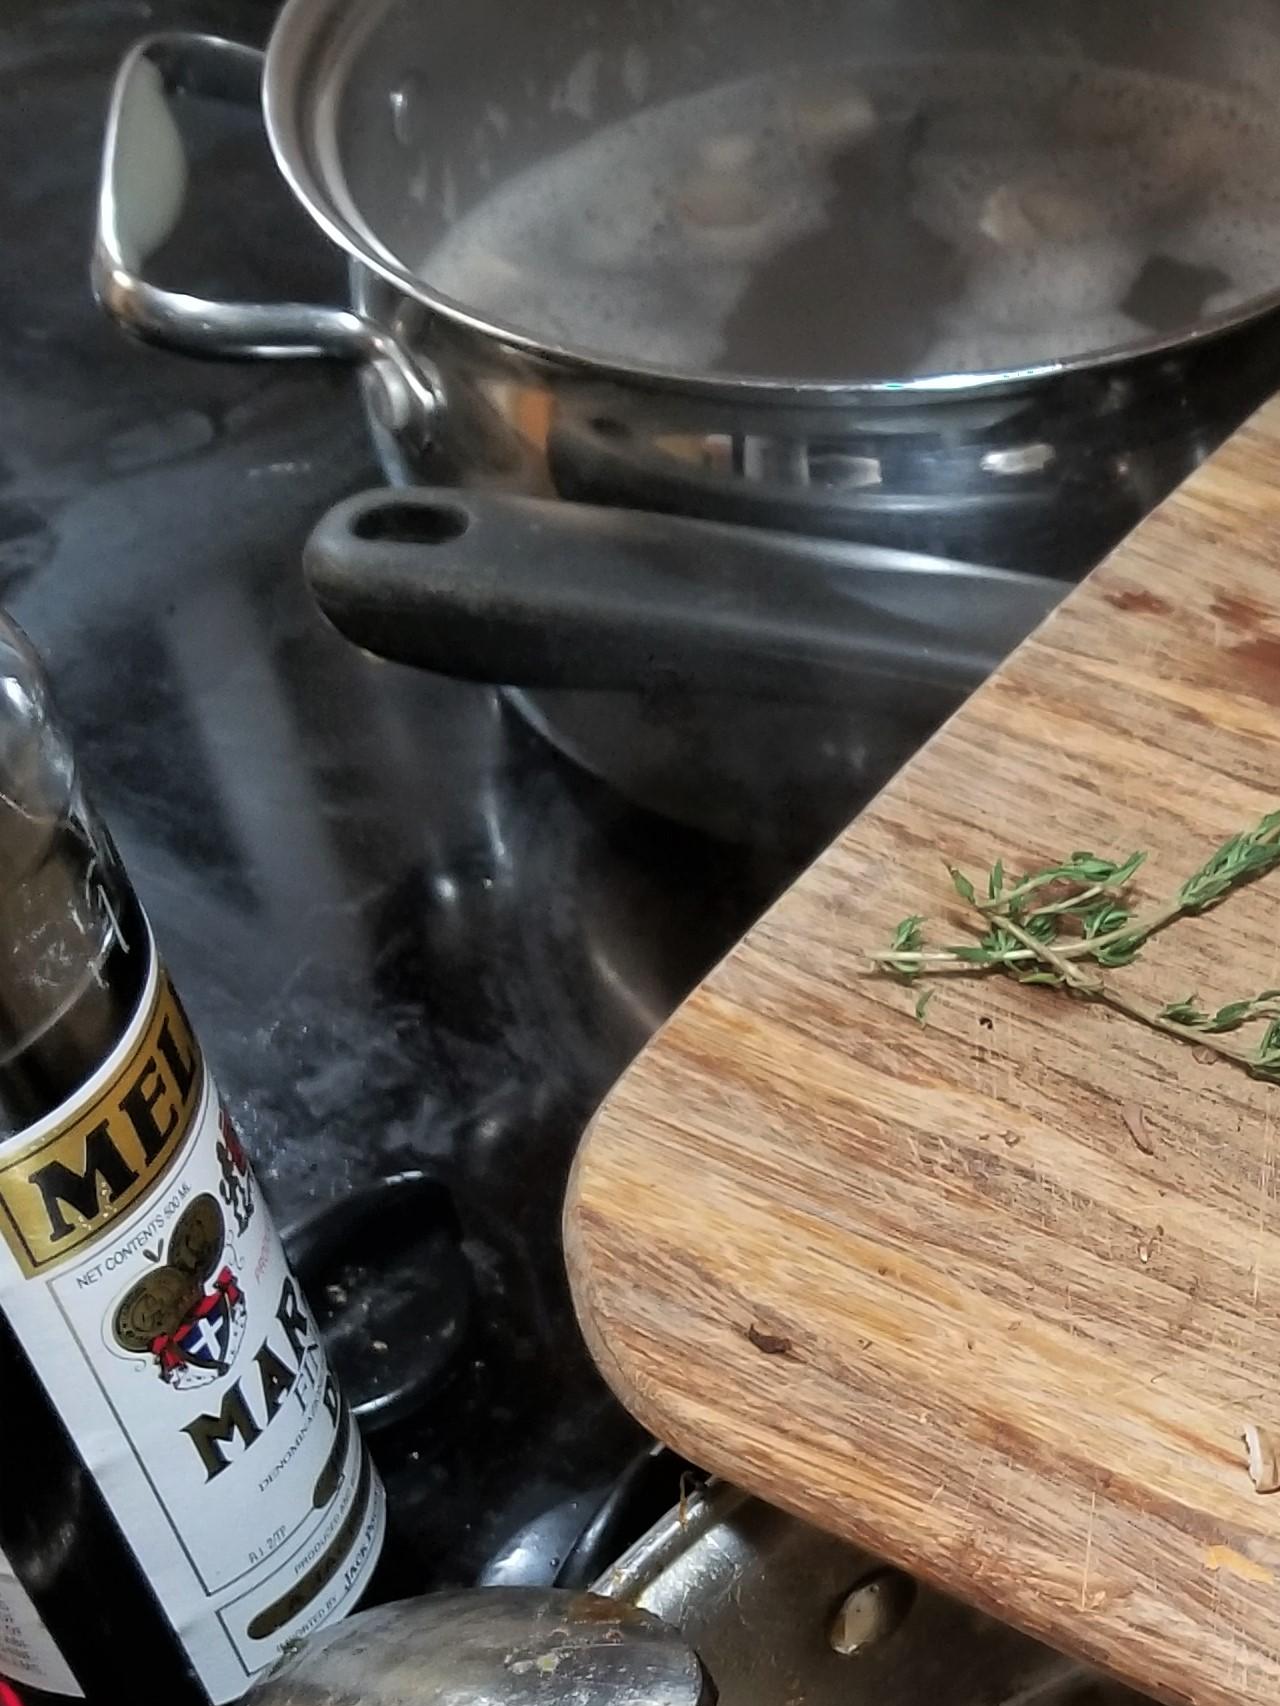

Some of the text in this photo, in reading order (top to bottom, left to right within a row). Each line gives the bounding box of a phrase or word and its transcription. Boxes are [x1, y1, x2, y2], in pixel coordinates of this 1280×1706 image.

[76, 1263, 104, 1290] NET
[104, 1213, 166, 1272] CONTENTS
[163, 1196, 182, 1225] 500
